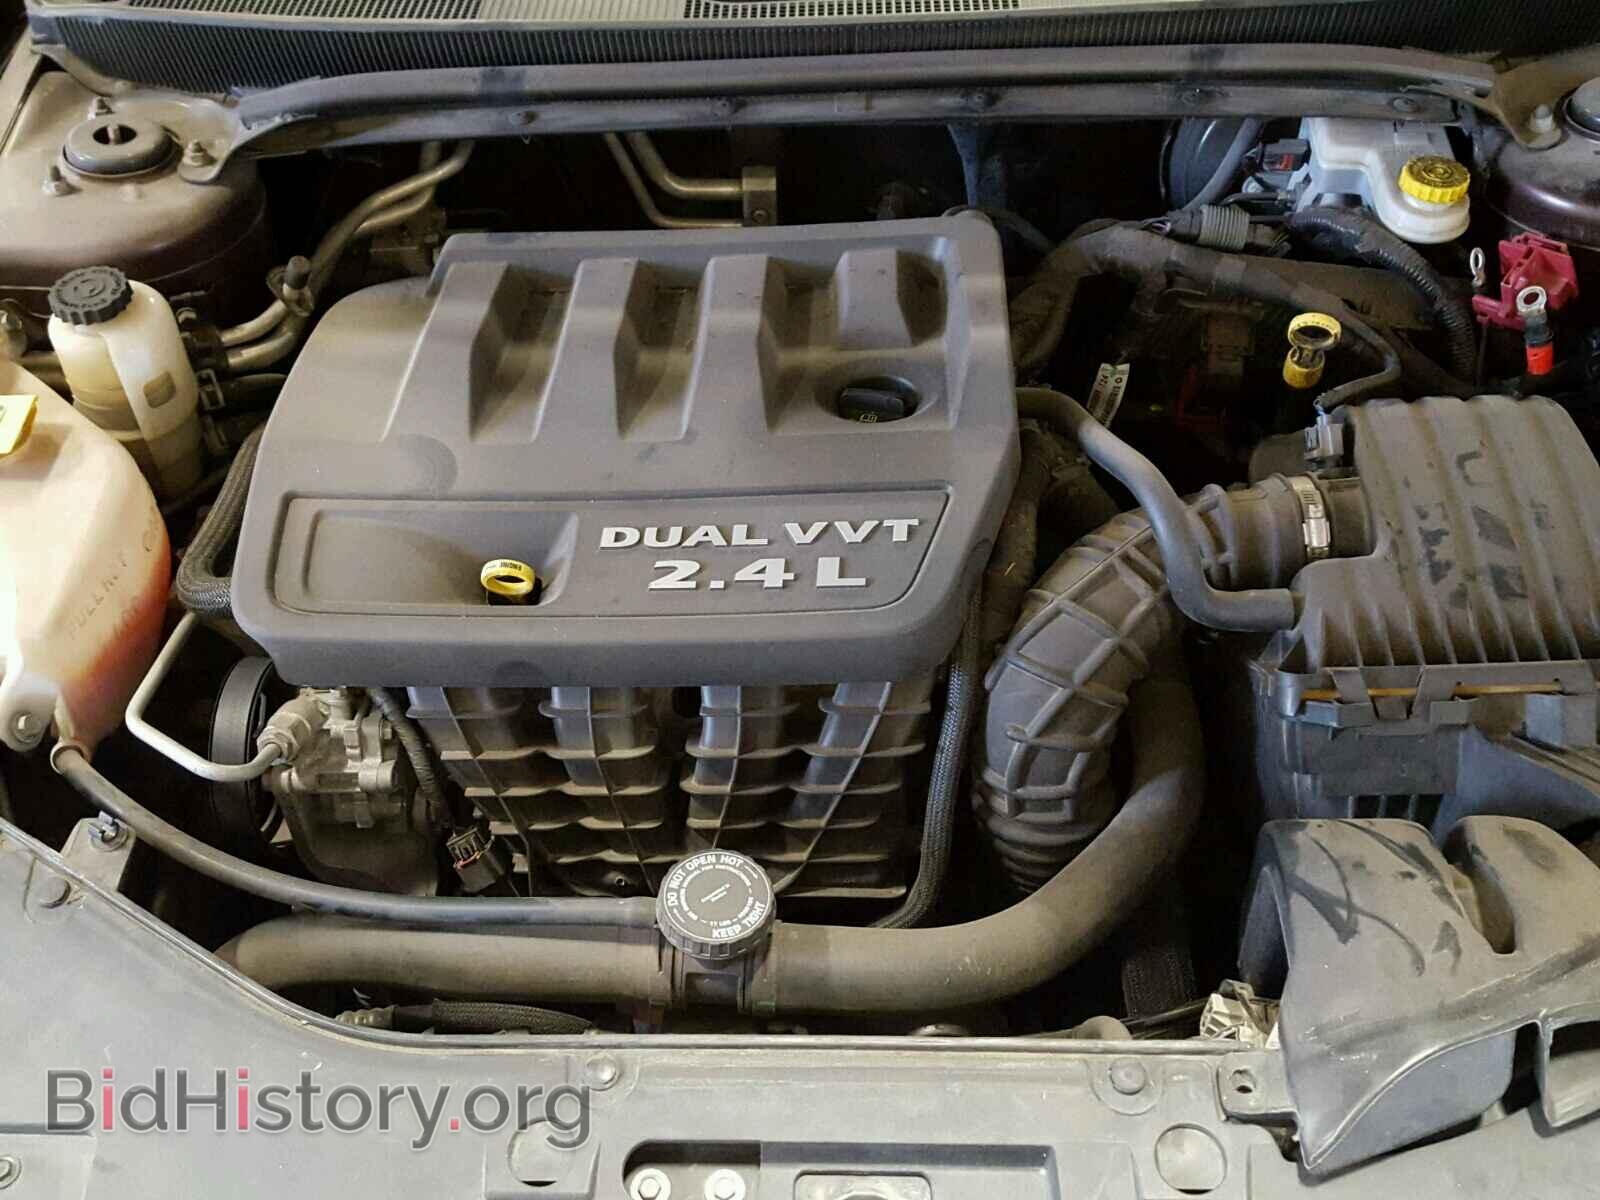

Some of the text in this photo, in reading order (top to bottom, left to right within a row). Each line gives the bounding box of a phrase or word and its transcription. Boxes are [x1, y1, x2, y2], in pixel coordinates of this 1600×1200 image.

[599, 518, 920, 548] DUAL VVT
[648, 556, 867, 590] 2.4 L
[685, 854, 716, 871] OPEN
[720, 854, 744, 868] HOT
[668, 870, 687, 890] NOT
[667, 892, 679, 907] DO
[712, 924, 742, 938] KEEP
[741, 900, 766, 927] TIGHT
